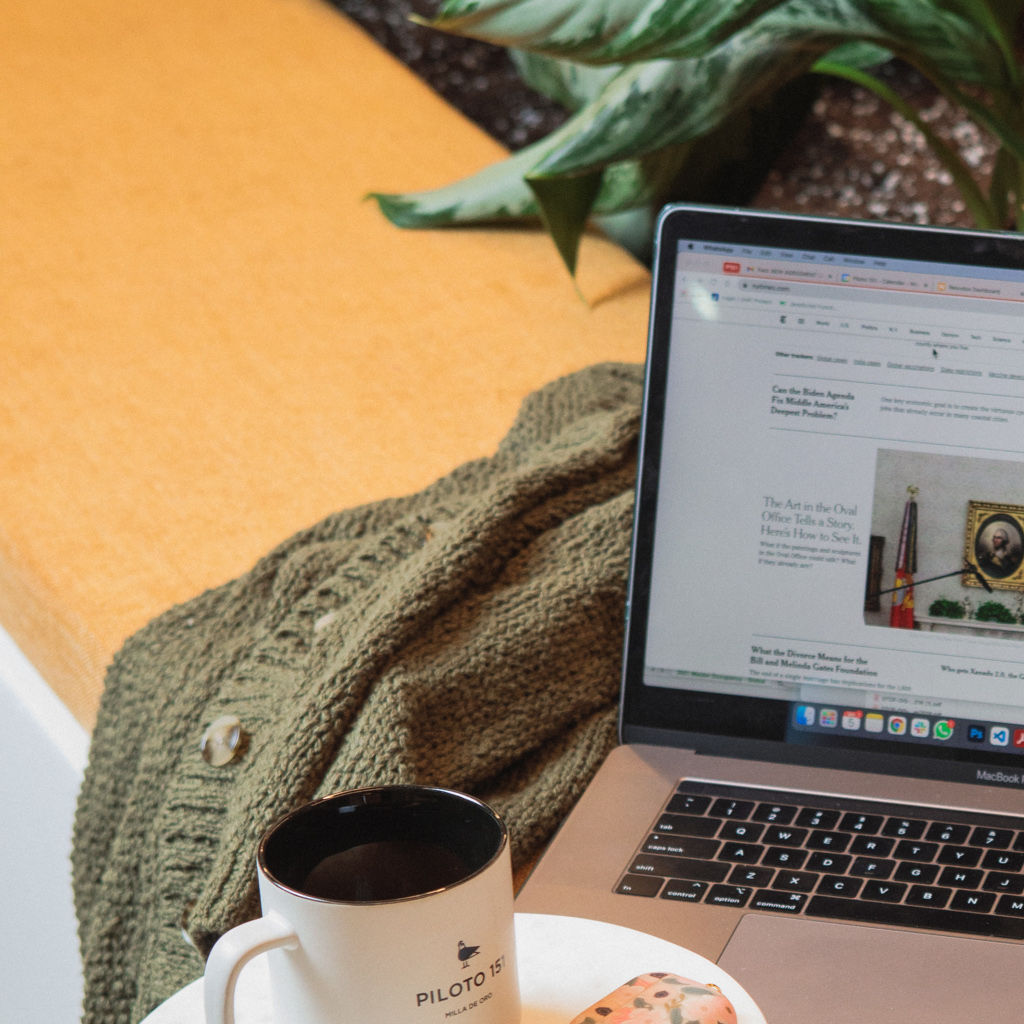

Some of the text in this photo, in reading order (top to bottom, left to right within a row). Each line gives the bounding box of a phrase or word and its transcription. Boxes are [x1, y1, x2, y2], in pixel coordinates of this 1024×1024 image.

[772, 386, 855, 401] Can the Biden Agenda
[771, 407, 837, 419] Deepest Problem?
[772, 396, 849, 411] Fix Middle America's
[763, 496, 858, 516] The Art in the Oval
[762, 511, 792, 524] Office
[794, 514, 816, 526] Tells
[760, 525, 862, 545] Here's How to See It.
[751, 646, 868, 665] What the Divorce Means for the
[750, 656, 878, 677] Bill and Melinda Gates Foundation
[941, 665, 956, 674] Who
[957, 668, 969, 676] gets
[1008, 672, 1018, 680] the
[970, 728, 983, 739] Ps
[977, 770, 1020, 784] MacBook
[659, 823, 673, 831] tab
[736, 827, 746, 835] Q
[778, 832, 791, 840] W
[823, 837, 832, 845] E
[867, 842, 876, 850] R
[648, 844, 666, 852] caps
[635, 864, 655, 872] shift
[923, 892, 932, 900] B
[1012, 902, 1024, 910] M
[667, 891, 696, 899] control
[714, 896, 740, 904] option
[756, 901, 796, 910] command
[416, 955, 506, 1006] PILOTO 151
[445, 992, 493, 1018] MILLA DE ORO
